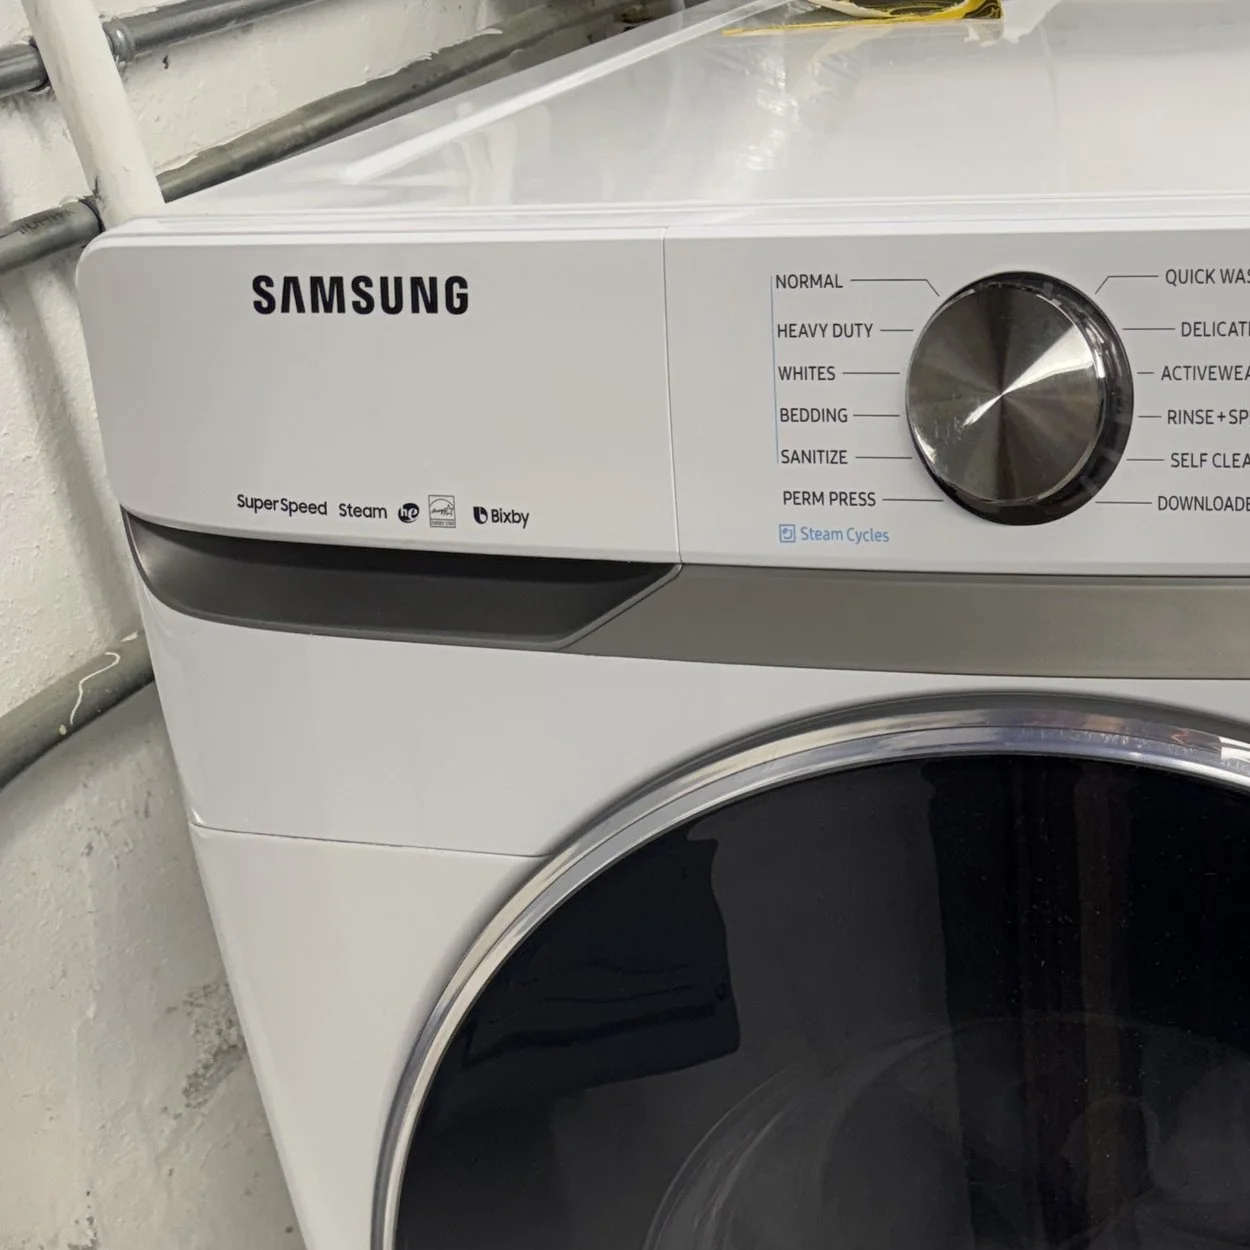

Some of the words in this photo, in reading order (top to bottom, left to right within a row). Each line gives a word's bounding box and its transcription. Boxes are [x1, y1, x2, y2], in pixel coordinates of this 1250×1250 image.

[775, 274, 844, 289] NORMAL
[1165, 269, 1217, 286] QUICK
[252, 275, 469, 315] SAMSUNG
[777, 323, 829, 339] HEAVY
[832, 323, 873, 338] DUTY
[778, 366, 836, 381] WHITES
[779, 408, 848, 423] BEDDING
[780, 449, 848, 465] SANITIZE
[1170, 453, 1208, 468] SELF
[783, 491, 825, 506] PERM
[829, 491, 876, 507] PRESS
[339, 502, 388, 520] Steam
[491, 507, 530, 529] Bixby
[800, 526, 843, 541] Steam
[846, 527, 890, 544] Cycles
